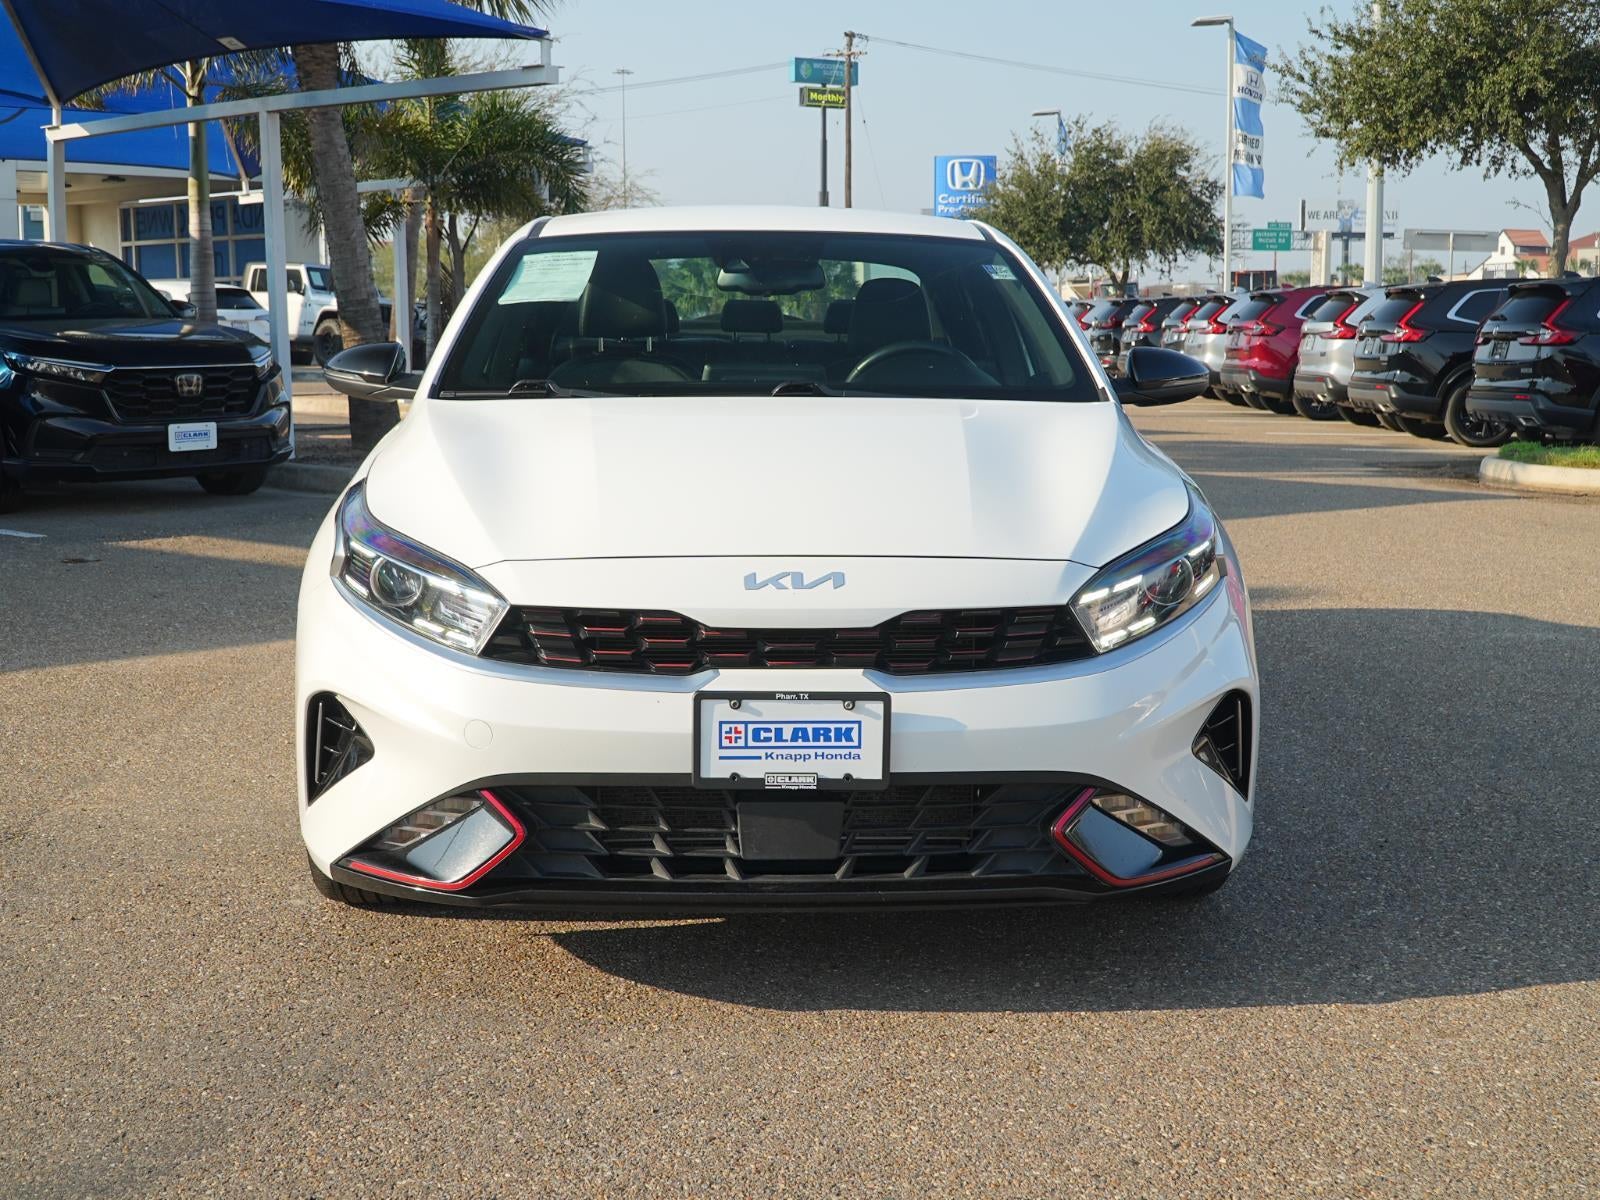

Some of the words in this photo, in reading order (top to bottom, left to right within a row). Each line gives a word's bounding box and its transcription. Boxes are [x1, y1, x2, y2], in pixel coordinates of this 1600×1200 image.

[809, 91, 845, 104] Monthly
[1237, 86, 1263, 101] HONDA
[1307, 210, 1320, 220] WE
[751, 727, 855, 743] CLARK
[764, 751, 812, 762] Knapp
[814, 751, 861, 761] Honda
[776, 775, 815, 783] CLARK
